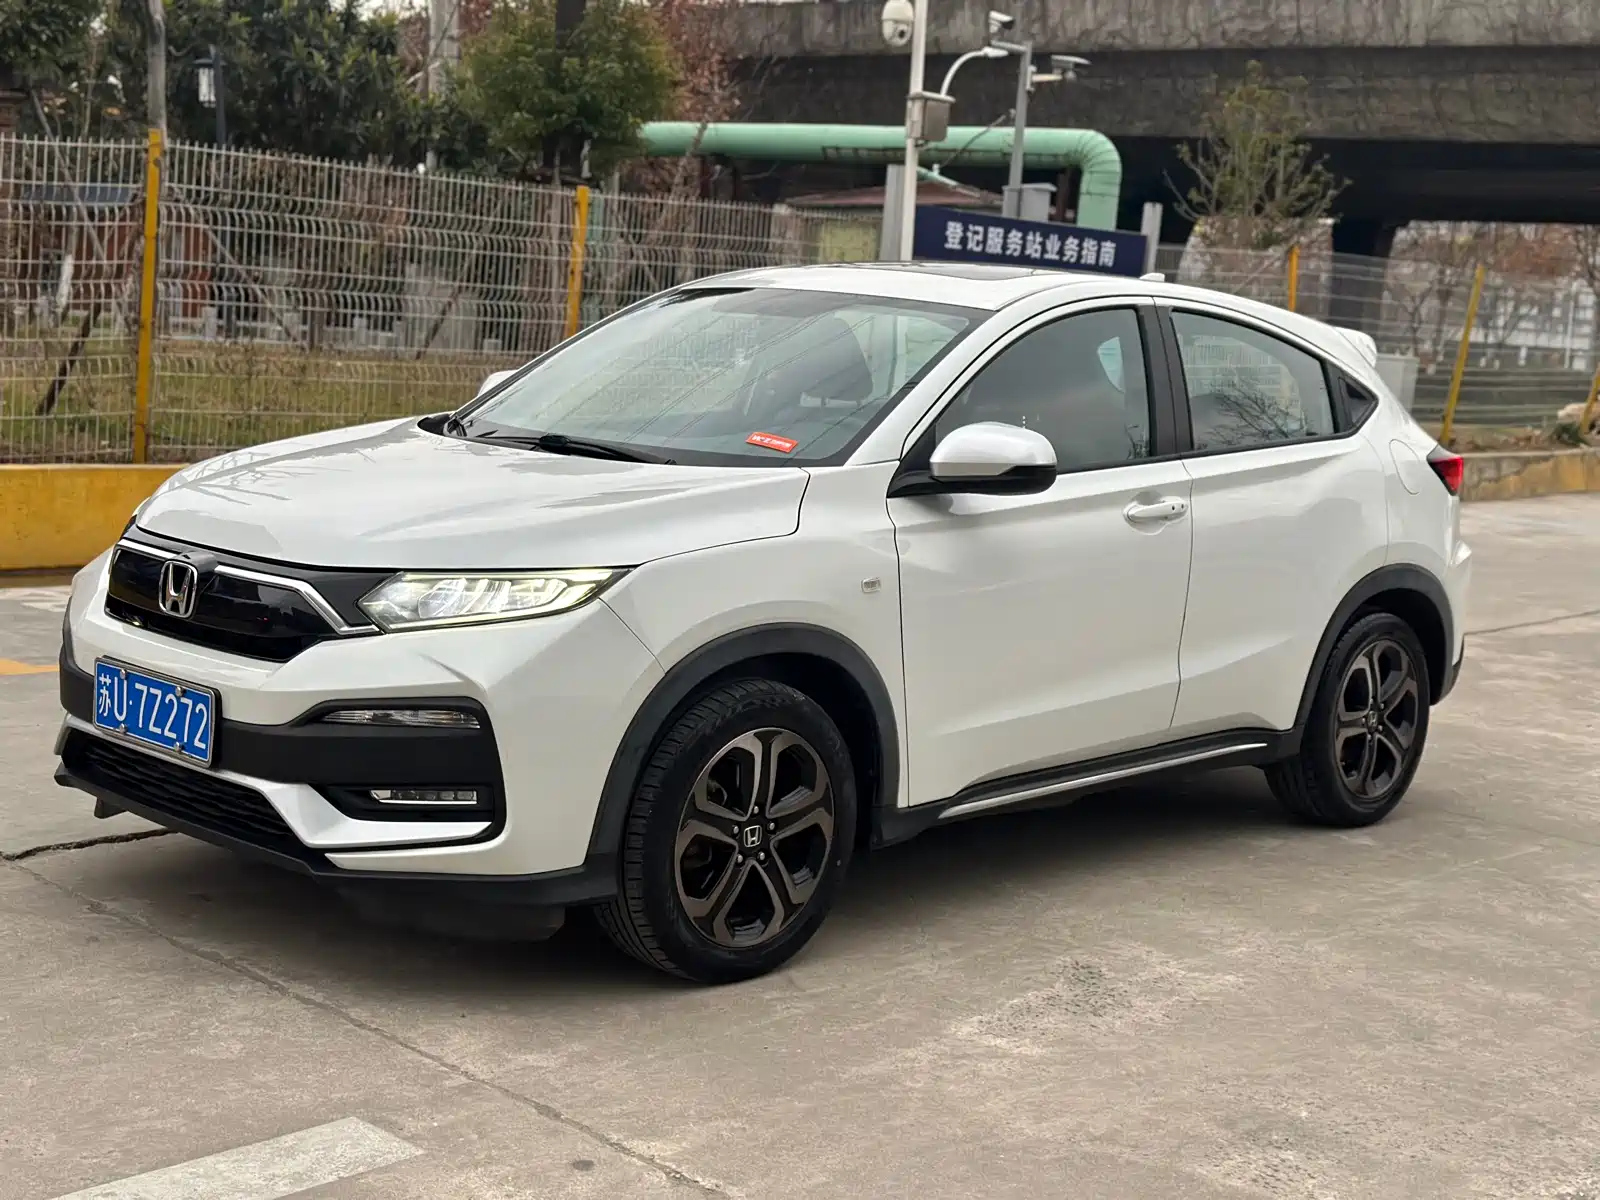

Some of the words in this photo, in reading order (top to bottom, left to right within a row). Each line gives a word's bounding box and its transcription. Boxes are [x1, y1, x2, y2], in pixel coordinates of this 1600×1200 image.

[943, 220, 1117, 268] 登记服务站业务指南
